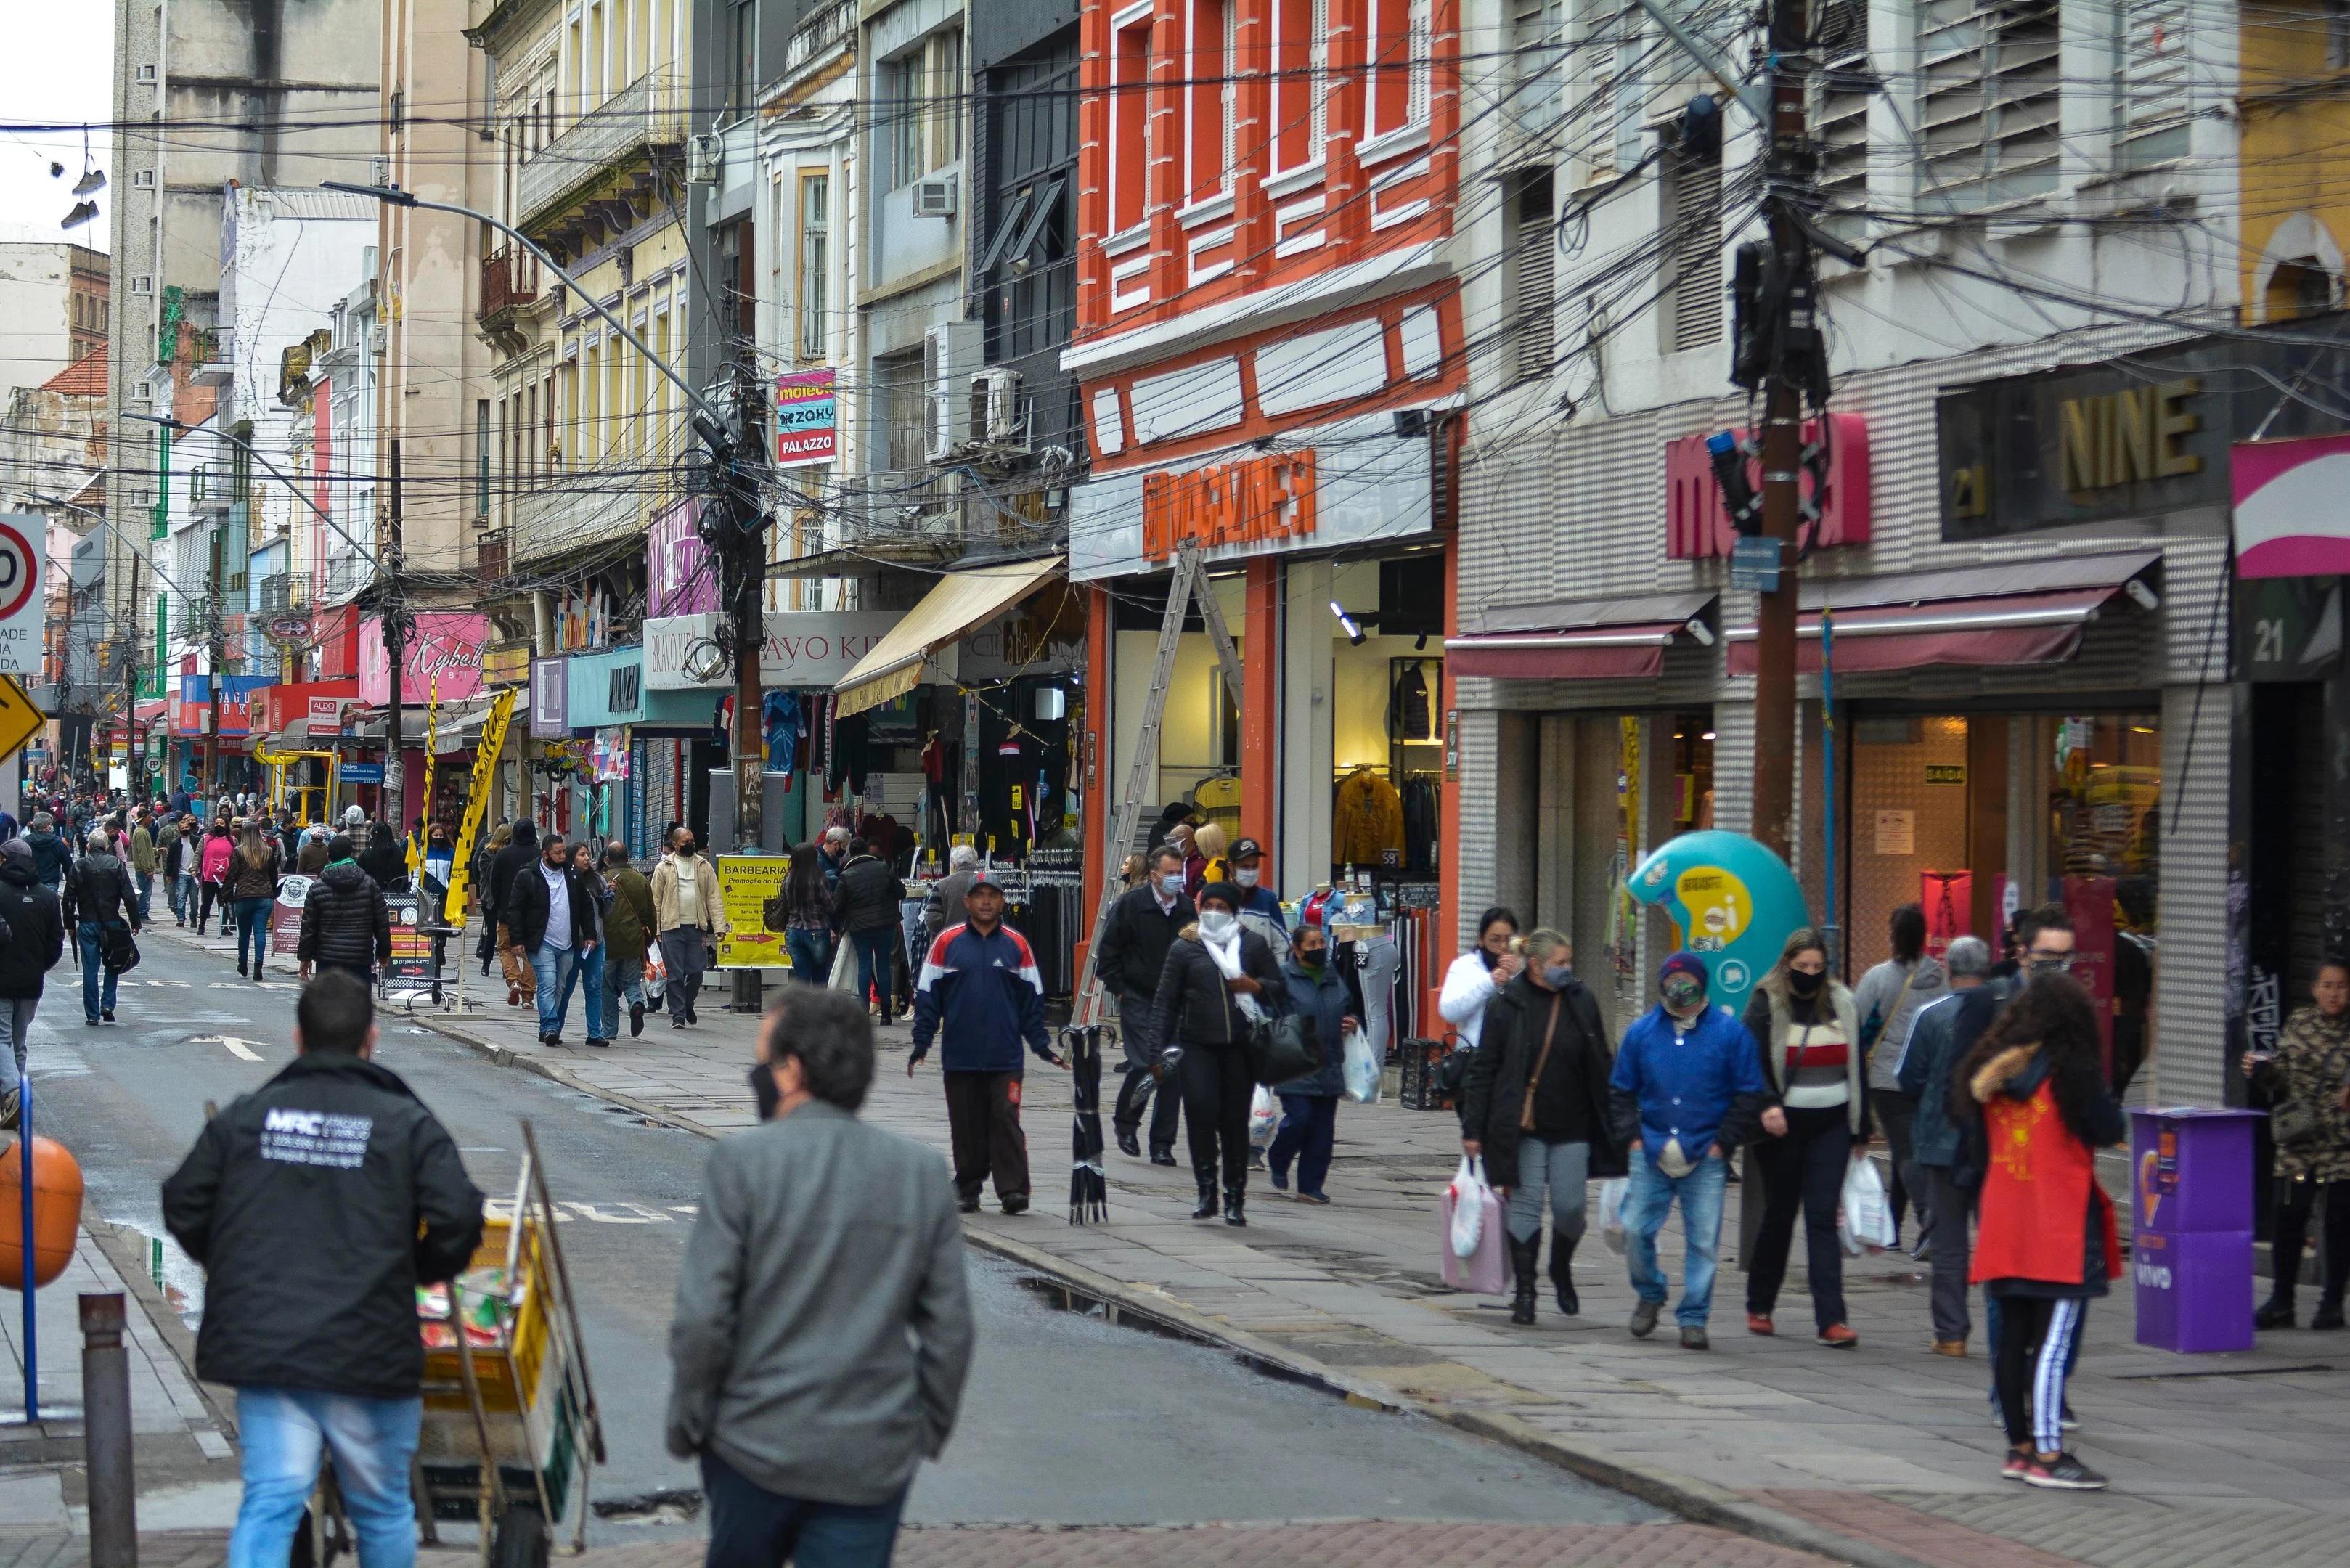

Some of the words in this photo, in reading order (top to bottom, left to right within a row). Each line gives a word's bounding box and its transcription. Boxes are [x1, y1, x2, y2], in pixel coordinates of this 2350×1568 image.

[783, 436, 832, 454] PALAZZO
[2059, 377, 2201, 491] NINE
[651, 634, 677, 673] BRAVO
[763, 636, 829, 661] AVO
[2254, 619, 2285, 662] 21
[725, 866, 787, 875] BARBEARIA
